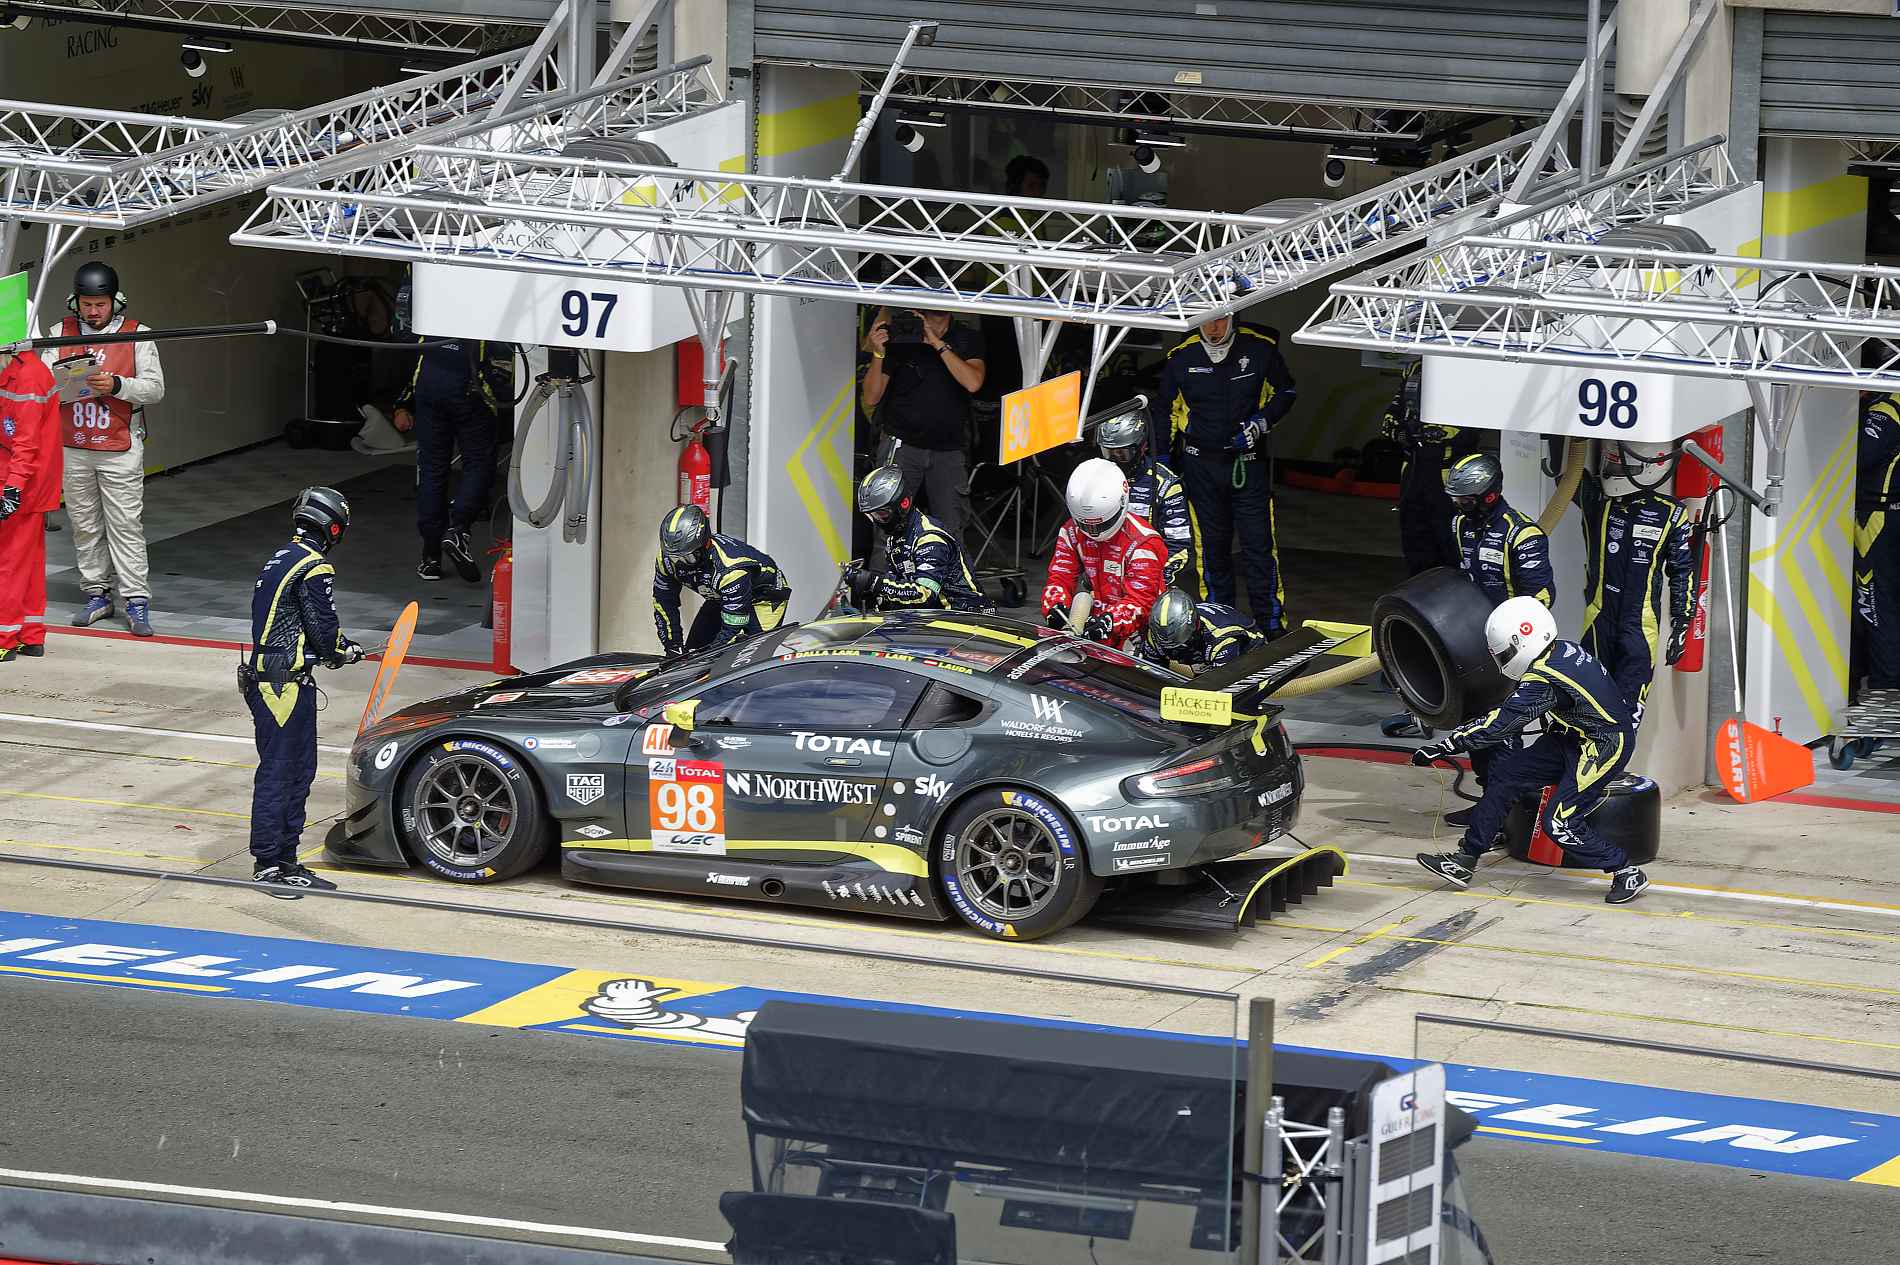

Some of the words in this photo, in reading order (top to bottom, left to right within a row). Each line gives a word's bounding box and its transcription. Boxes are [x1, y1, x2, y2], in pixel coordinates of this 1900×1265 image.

[66, 28, 118, 59] RACING
[495, 233, 556, 250] RACING
[561, 290, 618, 338] 97
[1578, 378, 1638, 429] 98
[73, 402, 110, 429] 898
[938, 662, 974, 676] LAUDA
[1163, 691, 1230, 712] HACKETT
[1000, 719, 1045, 734] WALDORF
[1045, 725, 1083, 738] ASTORIA
[1005, 730, 1034, 739] HOTELS
[461, 741, 510, 765] MICHELIN
[791, 731, 891, 757] TOTAL
[677, 765, 721, 778] TOTAL
[1727, 724, 1747, 797] START
[570, 775, 602, 788] TAG
[569, 788, 602, 803] HEUER
[657, 783, 716, 832] 98
[1026, 797, 1071, 849] MICHELIN
[1087, 814, 1169, 833] TOTAL
[895, 832, 923, 845] SPIRENT
[947, 881, 994, 931] MICHELIN
